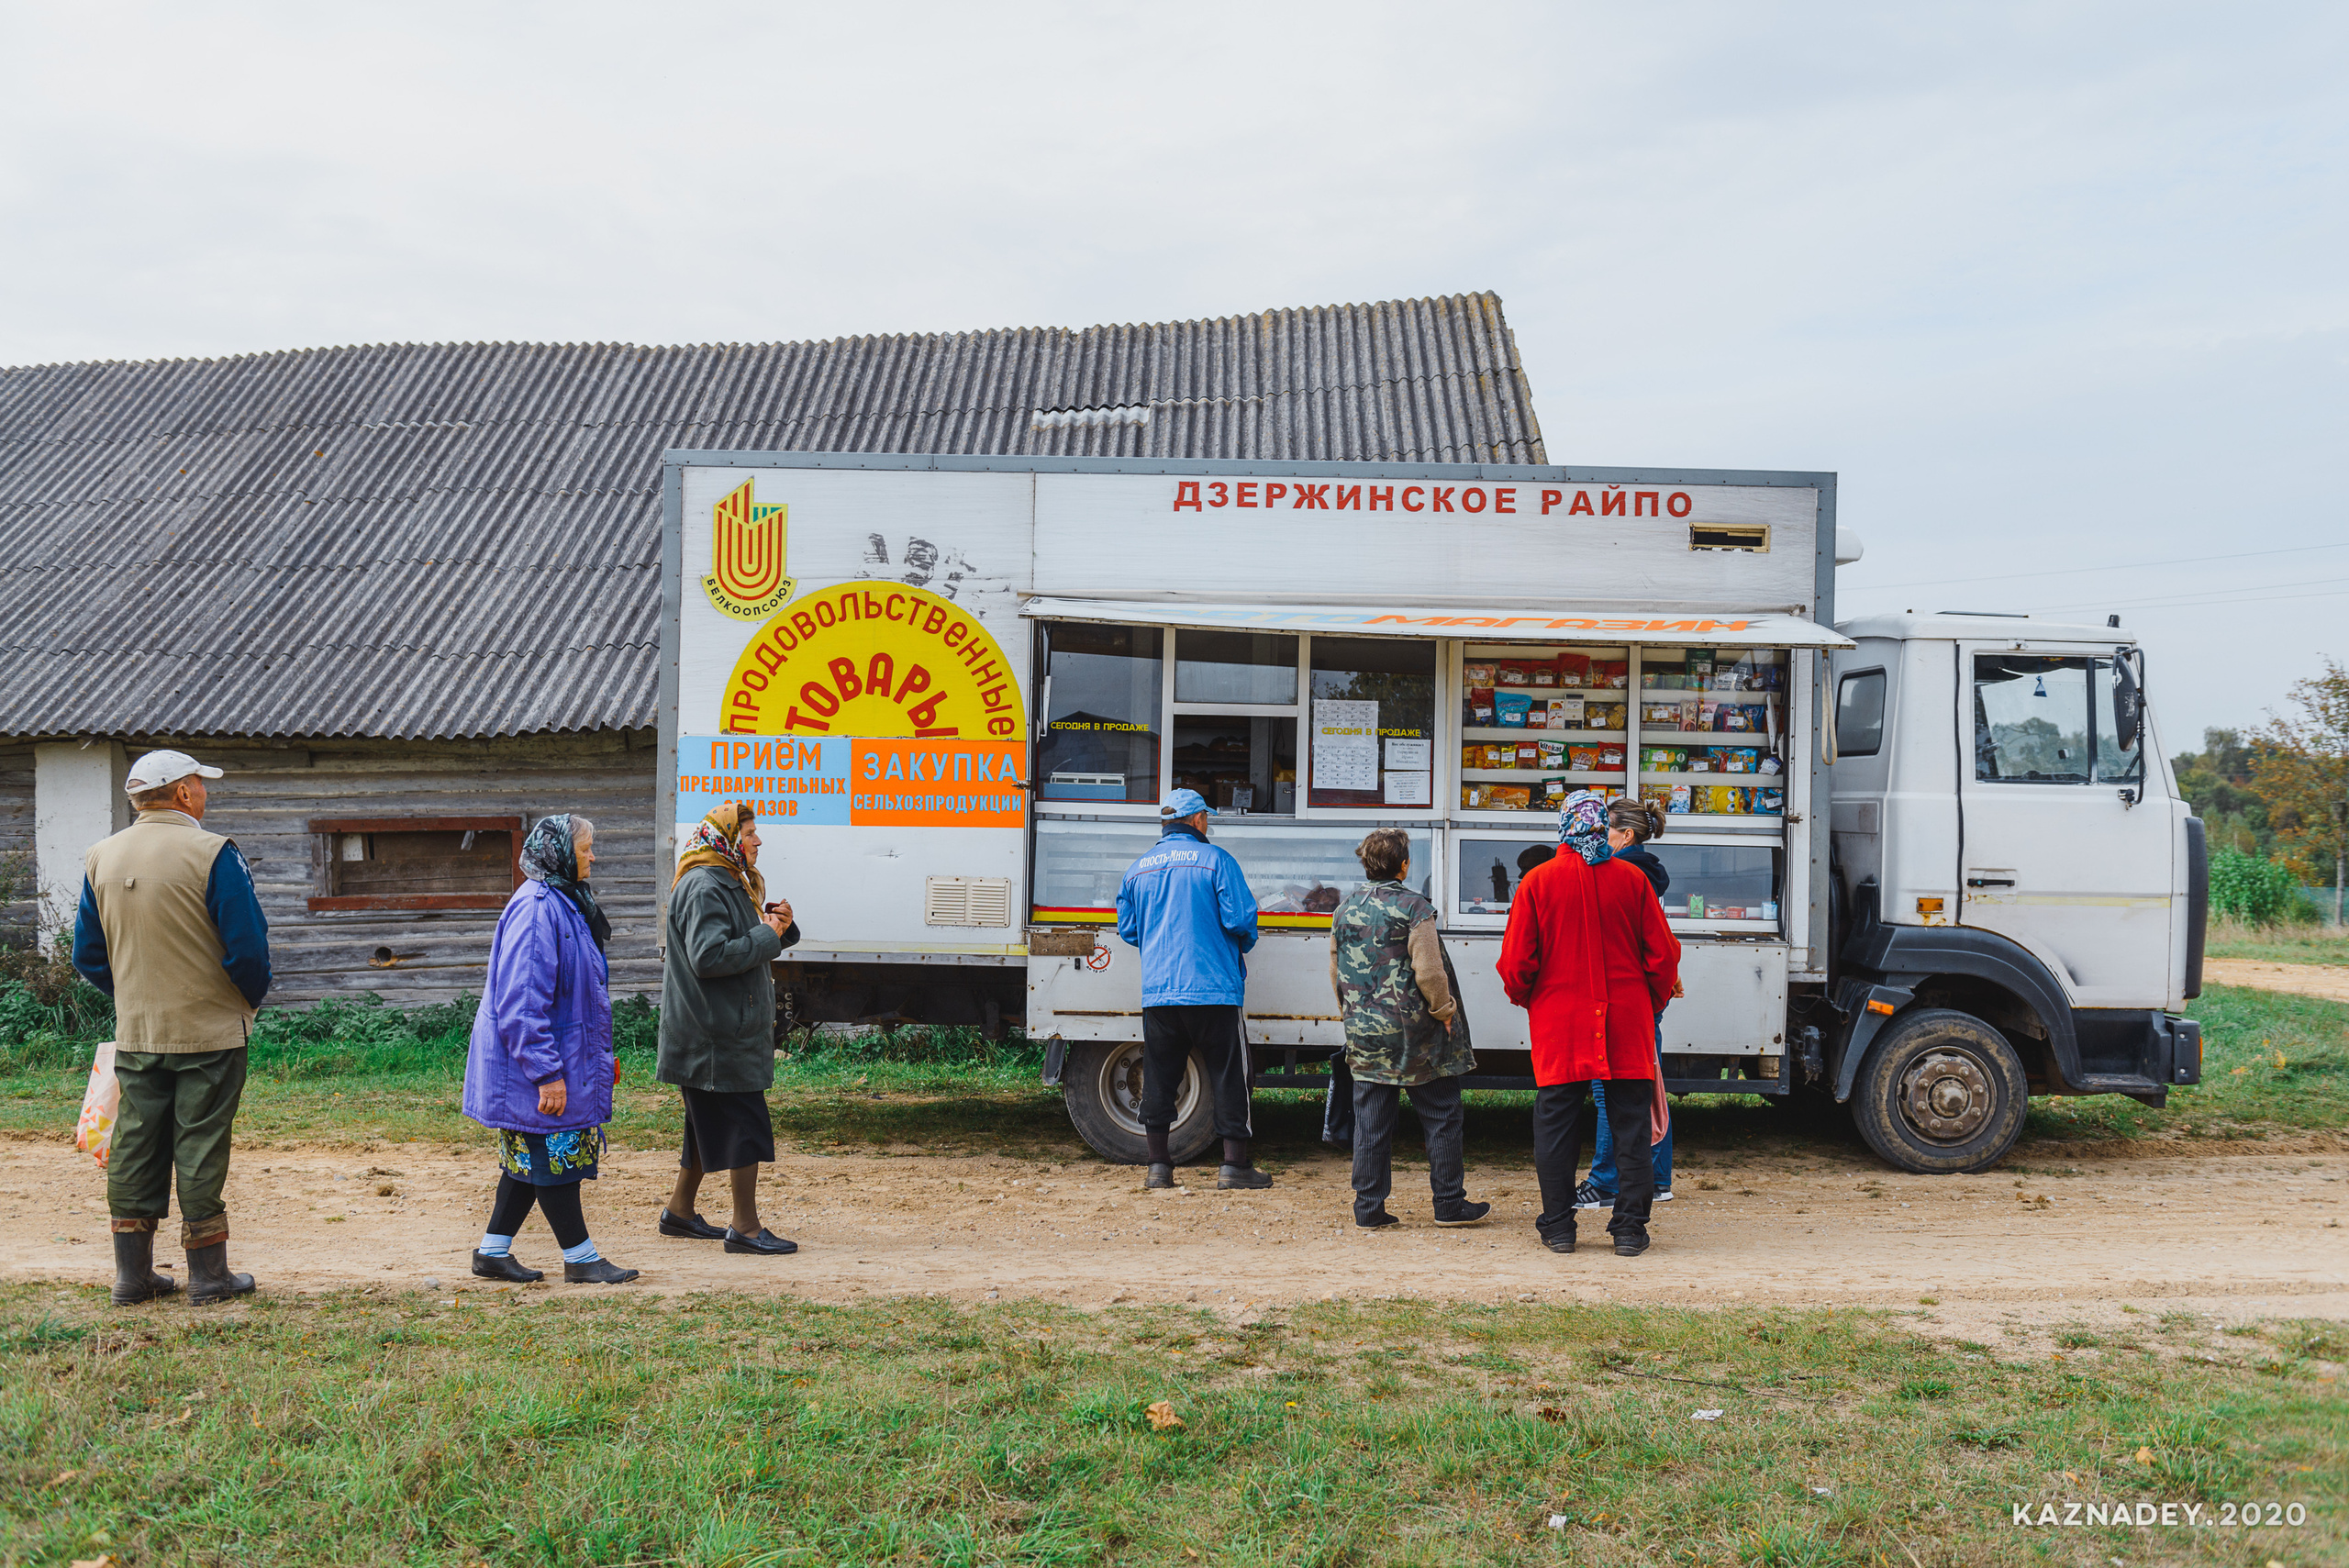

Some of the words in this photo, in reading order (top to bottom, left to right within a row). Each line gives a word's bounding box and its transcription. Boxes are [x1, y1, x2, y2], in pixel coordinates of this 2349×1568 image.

[1174, 482, 1517, 514] ДЗЕРЖИНСКОЕ
[1542, 485, 1692, 518] РАЙПО
[707, 578, 792, 617] БЕЛКООПСОЮЗ
[729, 590, 1016, 736] ПРОДОВОЛЬСТВЕННЫЕ
[785, 651, 959, 739] ТОВАРЫ
[1050, 721, 1091, 730] СЕГОДНЯ
[1094, 722, 1101, 731] В
[1103, 723, 1150, 732] ПРОДАЖЕ
[1321, 727, 1363, 736] СЕГОДНЯ
[1365, 728, 1373, 736] В
[1375, 728, 1421, 737] ПРОДАЖЕ
[1540, 741, 1563, 752] kitekat
[863, 752, 1018, 784] ЗАКУПКА
[680, 775, 846, 795] ПРЕДВАРИТЕЛЬНЫХ
[724, 799, 798, 817] КАЗОВ
[853, 794, 1021, 815] СЕЛЬХОЗПРОДУКЦИИ
